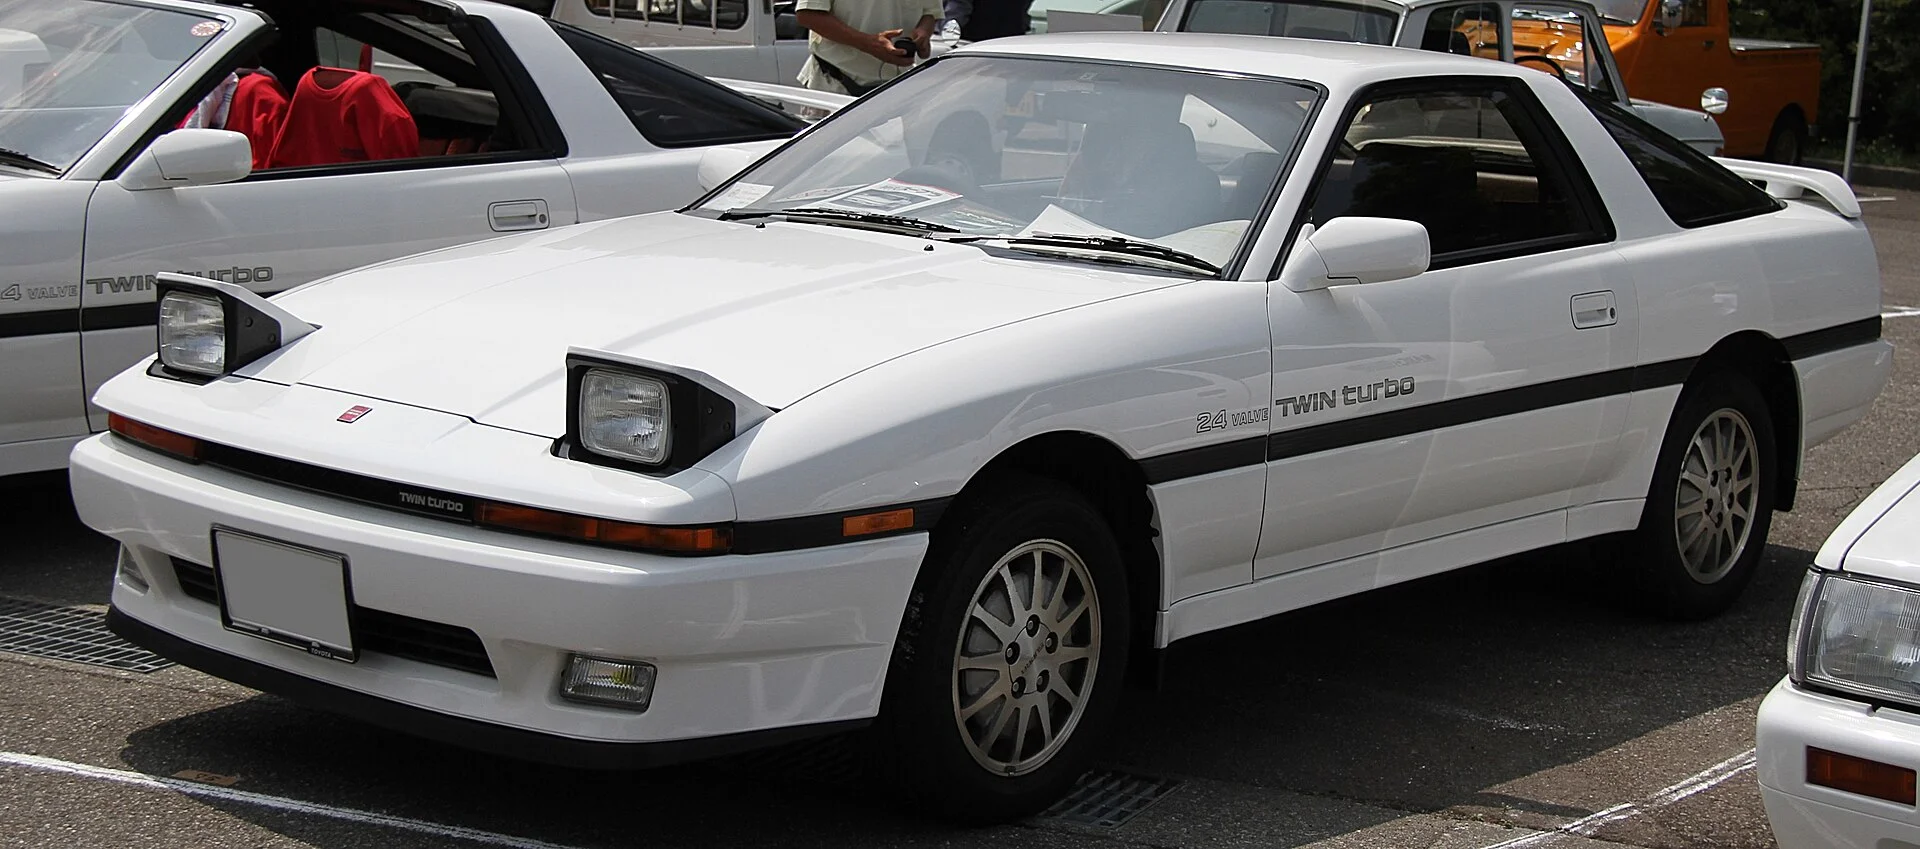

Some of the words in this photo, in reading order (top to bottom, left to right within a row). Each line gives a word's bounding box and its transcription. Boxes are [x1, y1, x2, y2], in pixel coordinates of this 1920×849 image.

[27, 285, 78, 299] VALVE
[1196, 409, 1228, 433] 24
[1231, 407, 1269, 427] VALVE
[1275, 389, 1337, 417] TWIN
[1341, 376, 1416, 406] turbo
[399, 492, 426, 506] TWIN
[427, 496, 464, 512] turbo
